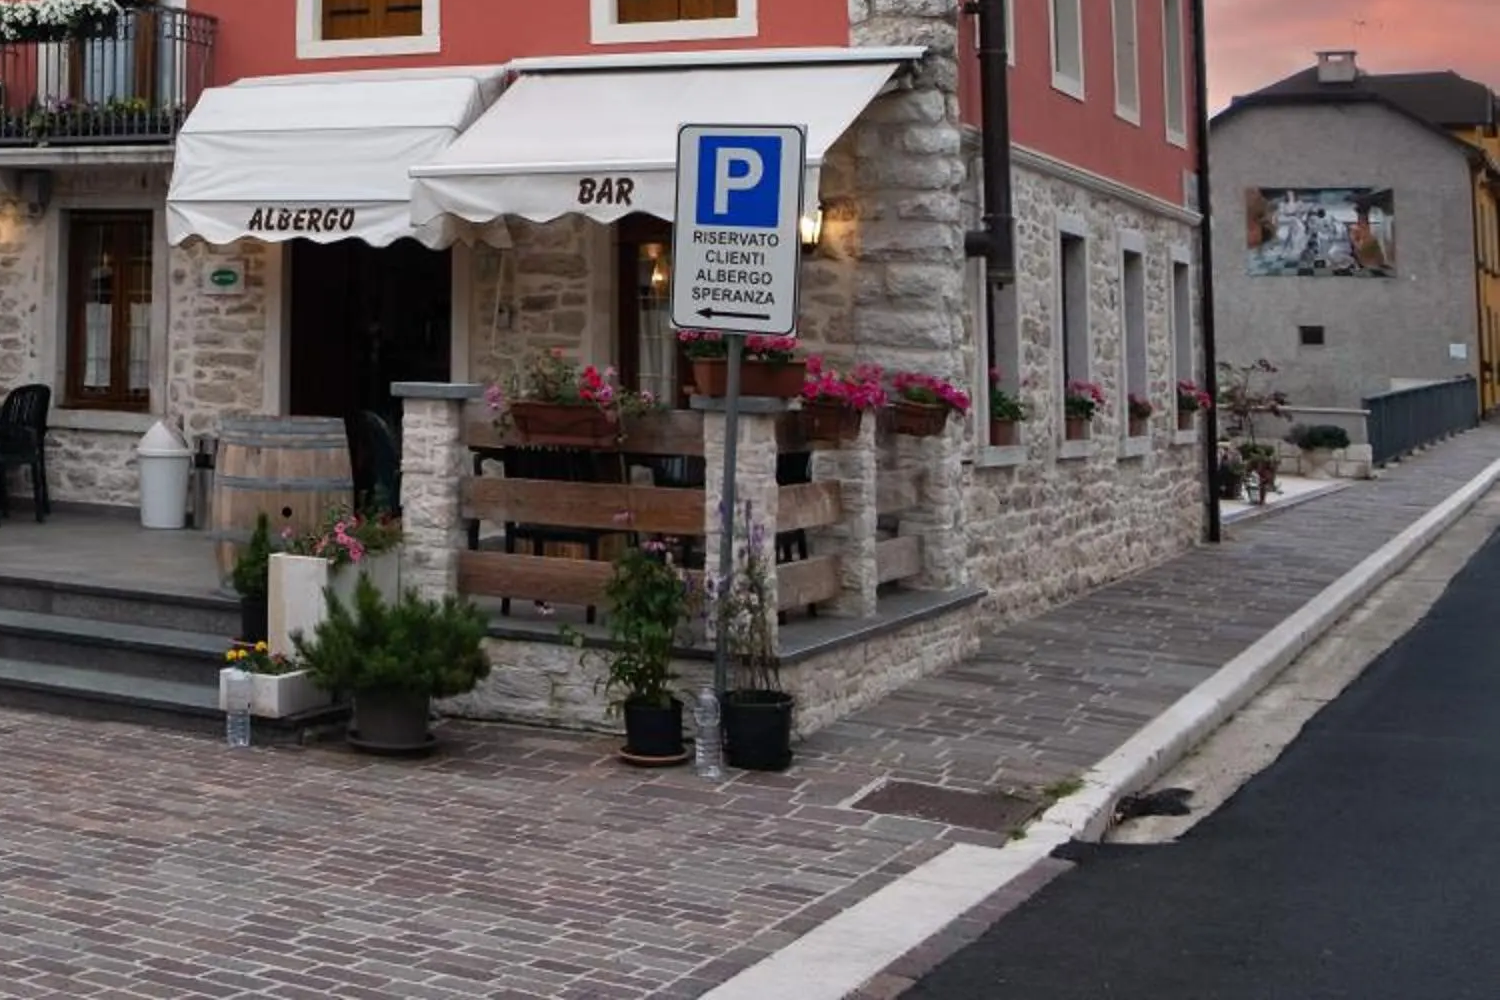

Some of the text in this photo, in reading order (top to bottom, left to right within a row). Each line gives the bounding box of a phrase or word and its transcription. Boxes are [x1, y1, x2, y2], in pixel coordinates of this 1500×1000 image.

[713, 146, 764, 215] P
[577, 177, 635, 206] BAR
[248, 207, 355, 233] ALBERGO
[692, 230, 780, 248] RISERVATO
[705, 249, 766, 266] CLIENTI
[695, 268, 774, 286] ALBERGO
[691, 286, 776, 306] SPERANZA
